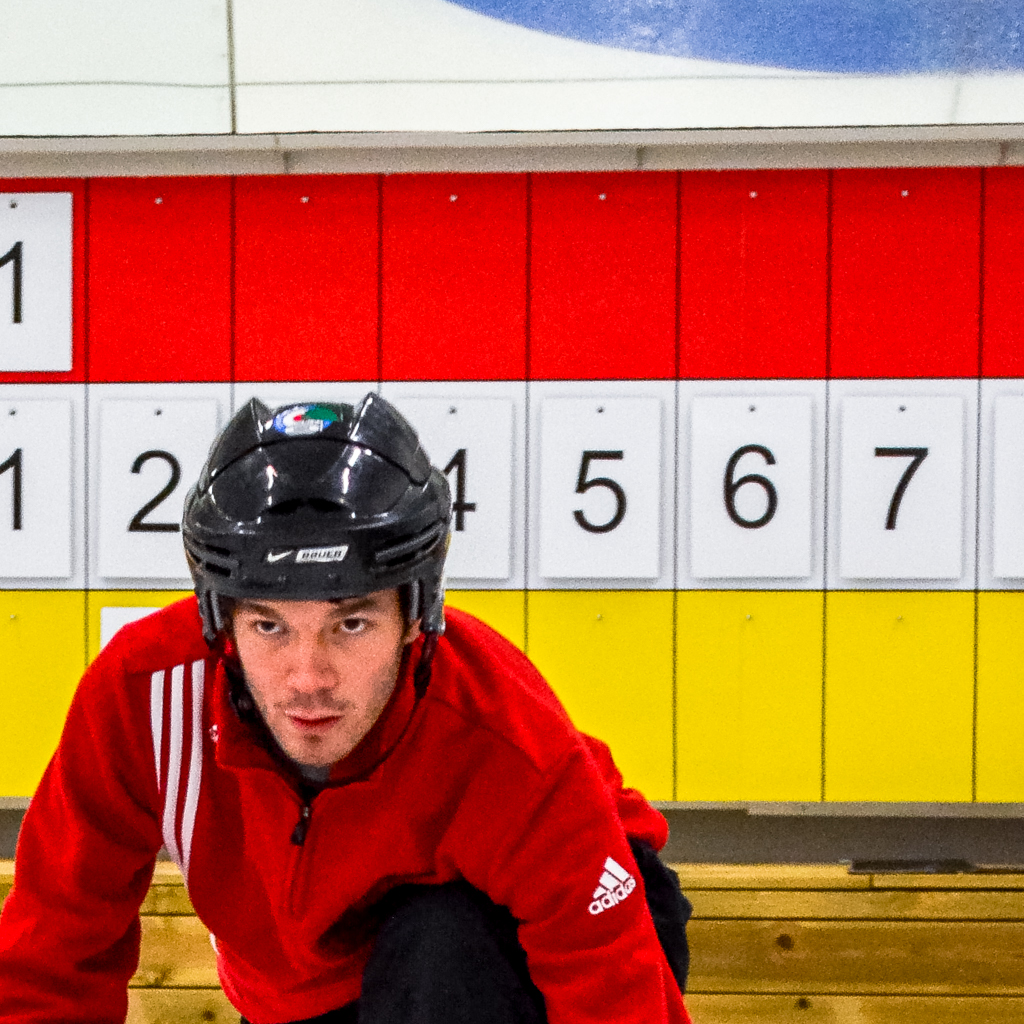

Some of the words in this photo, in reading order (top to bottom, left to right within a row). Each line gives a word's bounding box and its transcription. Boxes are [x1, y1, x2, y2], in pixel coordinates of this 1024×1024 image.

[128, 449, 181, 532] 2
[443, 448, 477, 532] 4
[573, 450, 627, 534] 5
[723, 444, 778, 529] 6
[874, 447, 929, 531] 7
[588, 875, 636, 915] adidas
